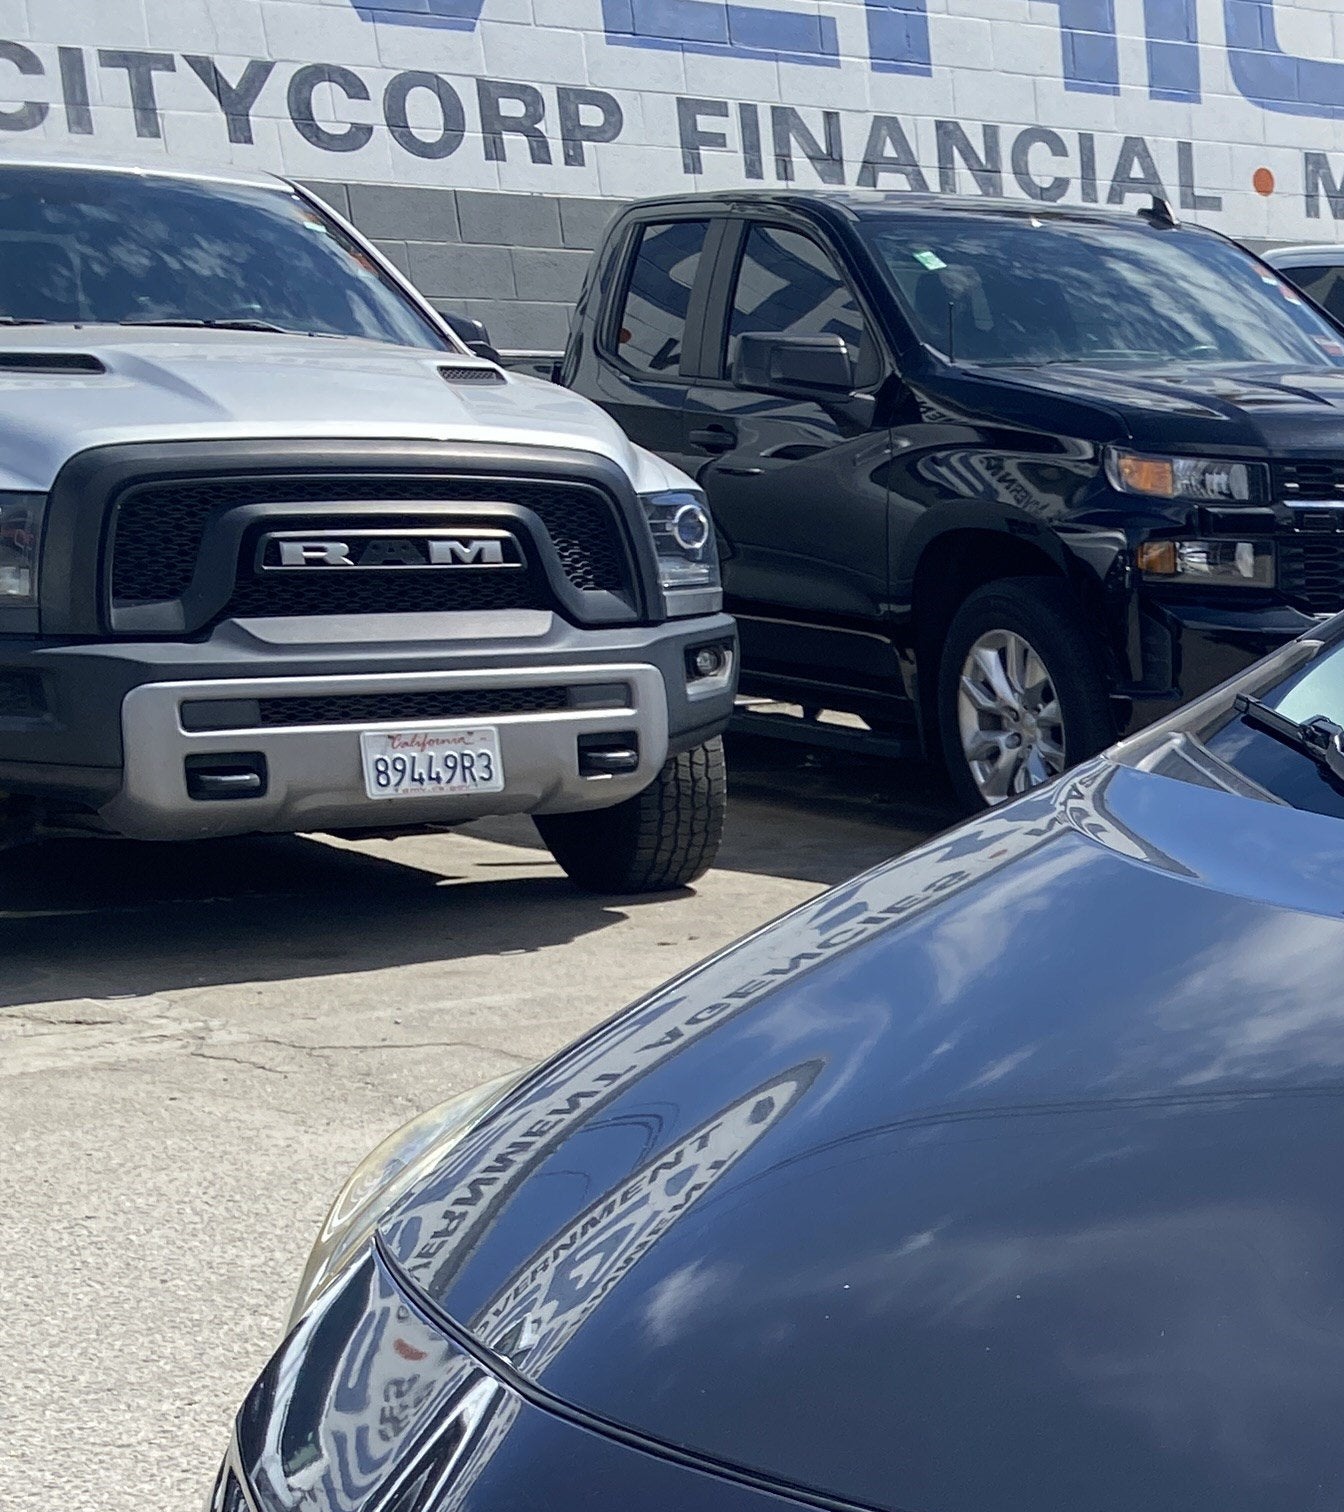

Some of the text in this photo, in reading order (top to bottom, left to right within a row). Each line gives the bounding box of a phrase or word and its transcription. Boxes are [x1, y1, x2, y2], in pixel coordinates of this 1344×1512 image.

[0, 40, 624, 167] CITYCORP
[675, 97, 1222, 212] FINANCIAL
[279, 539, 504, 566] RAM
[390, 732, 475, 752] California
[374, 752, 494, 788] 89449R3
